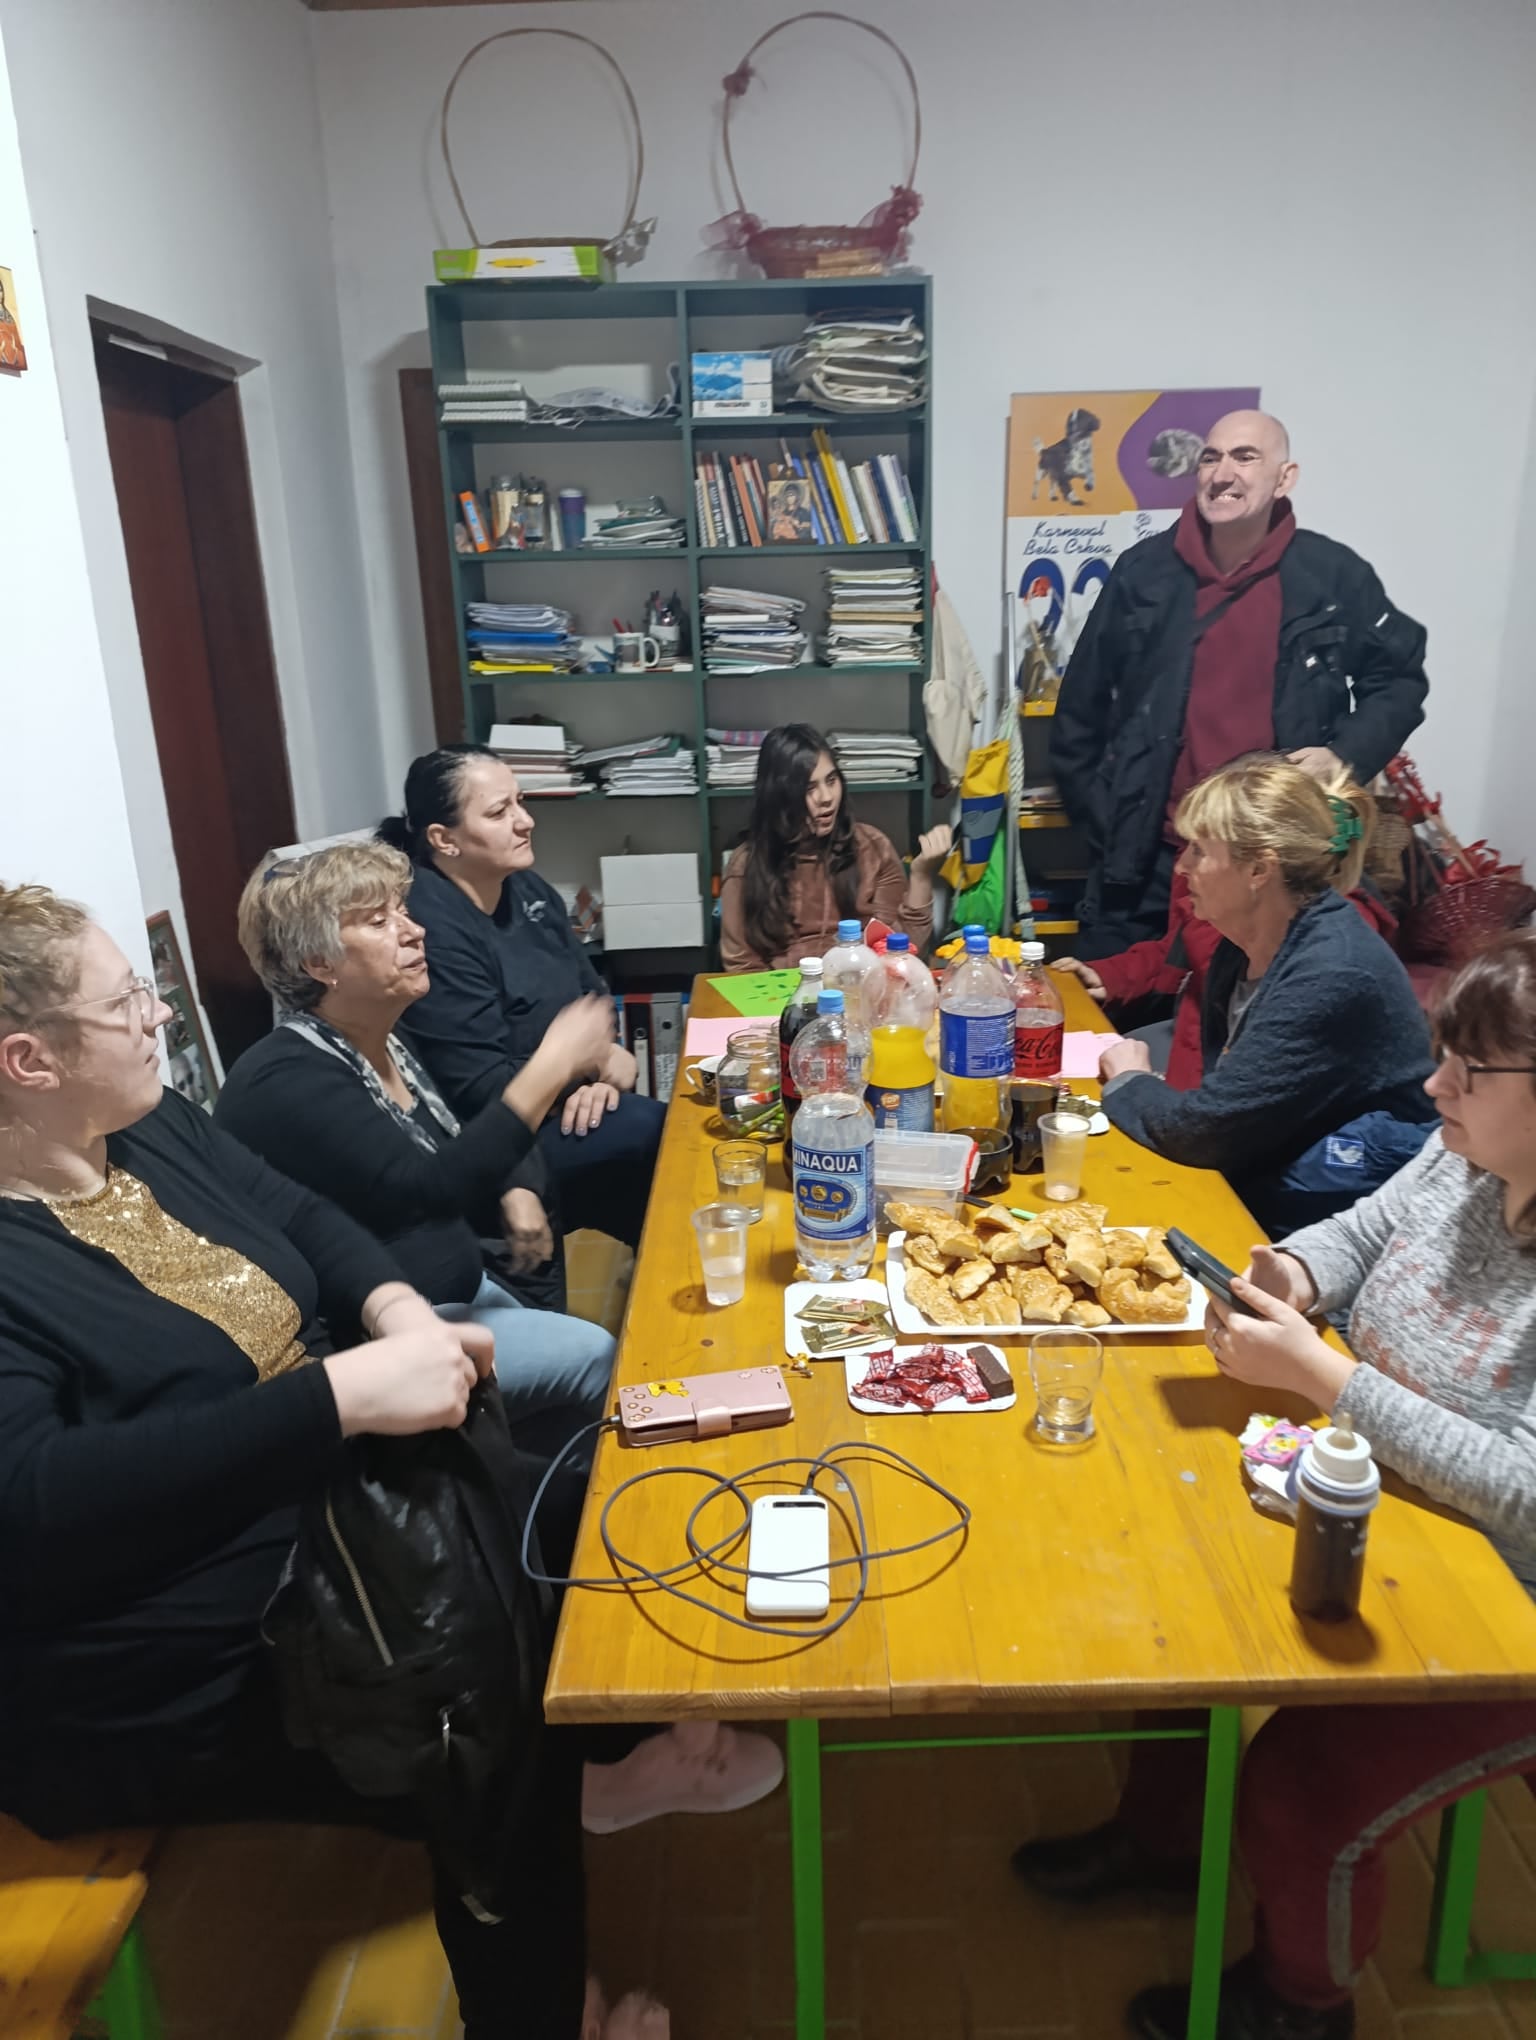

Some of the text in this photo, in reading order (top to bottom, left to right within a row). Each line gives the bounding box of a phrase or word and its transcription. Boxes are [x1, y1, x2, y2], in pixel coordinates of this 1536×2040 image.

[1032, 519, 1108, 538] Karneval
[1023, 537, 1113, 556] Bela Crkva
